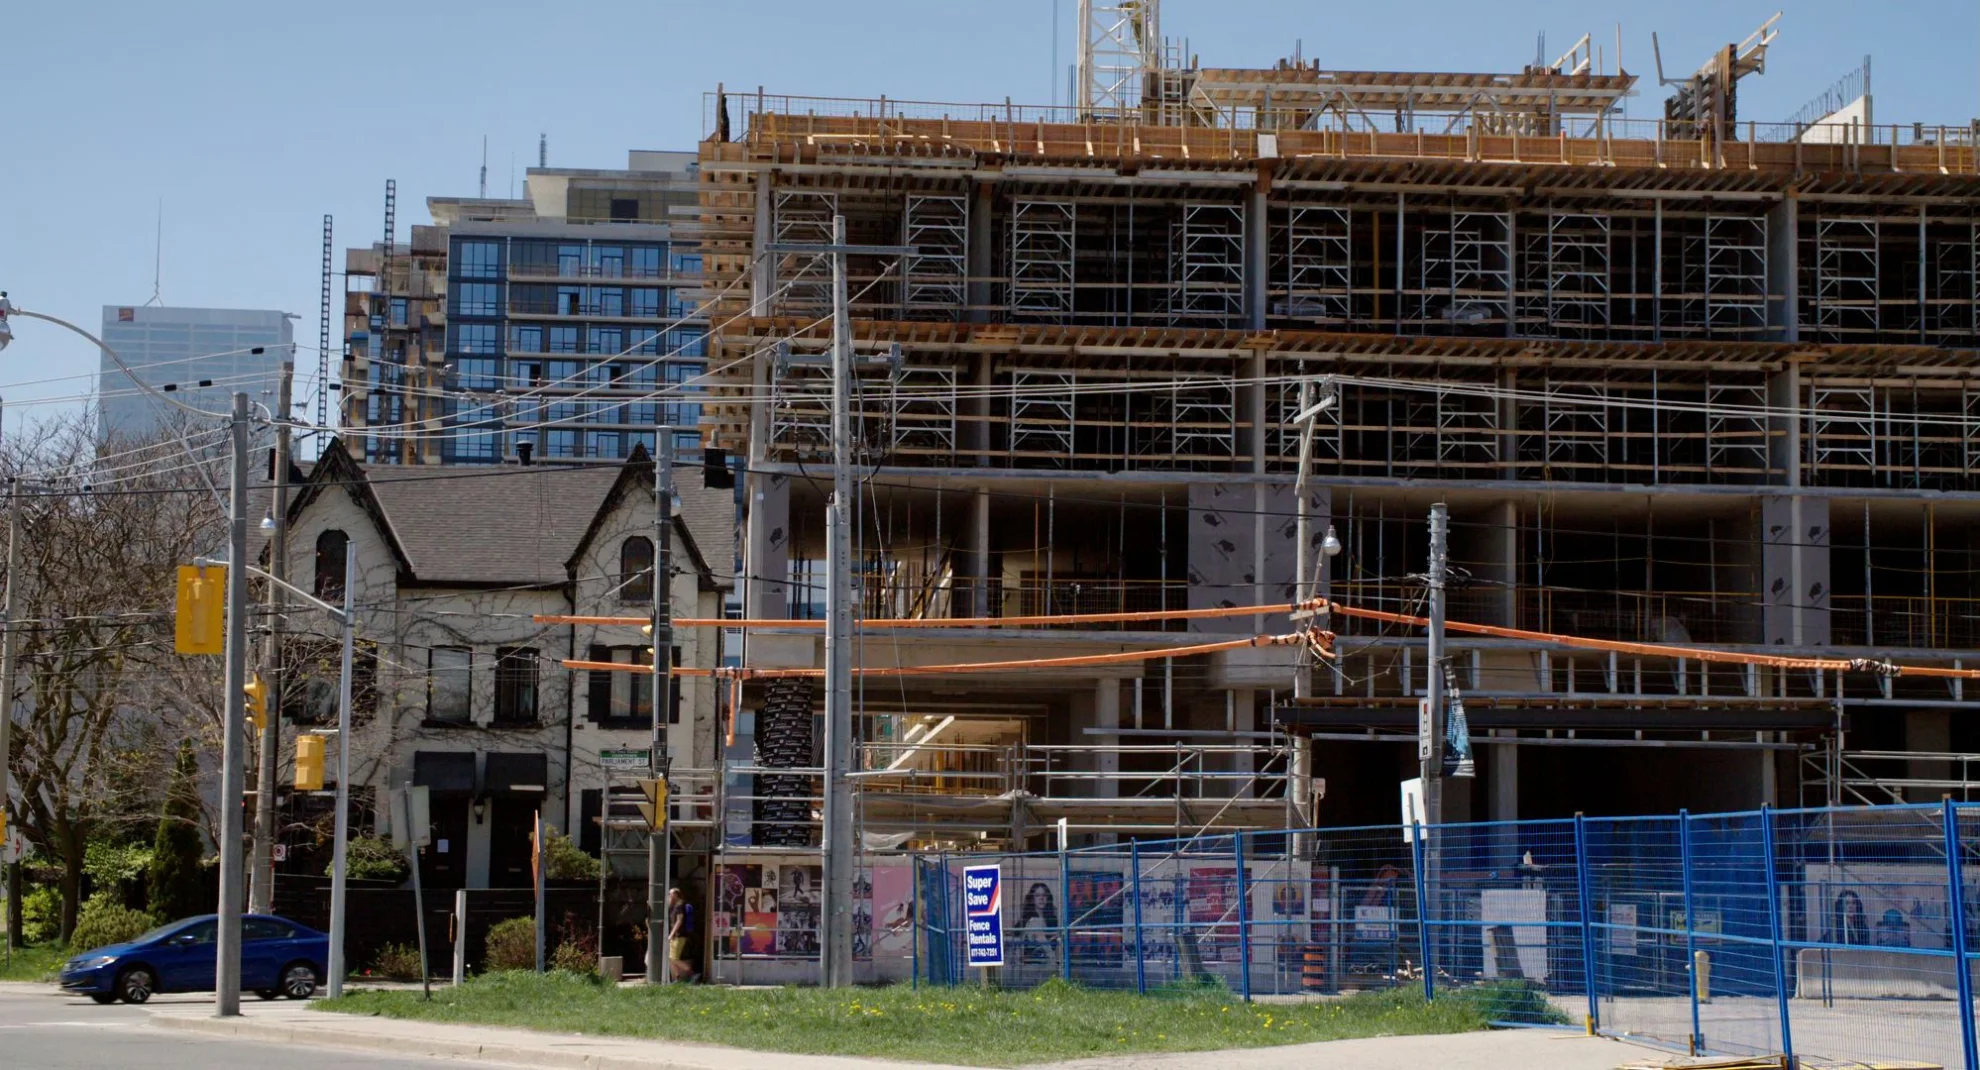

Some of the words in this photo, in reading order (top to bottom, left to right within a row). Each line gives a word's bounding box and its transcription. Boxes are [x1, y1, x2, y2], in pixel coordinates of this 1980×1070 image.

[967, 875, 992, 891] Super
[967, 892, 988, 906] Save
[969, 920, 990, 931] Fence
[970, 933, 996, 945] Rentals
